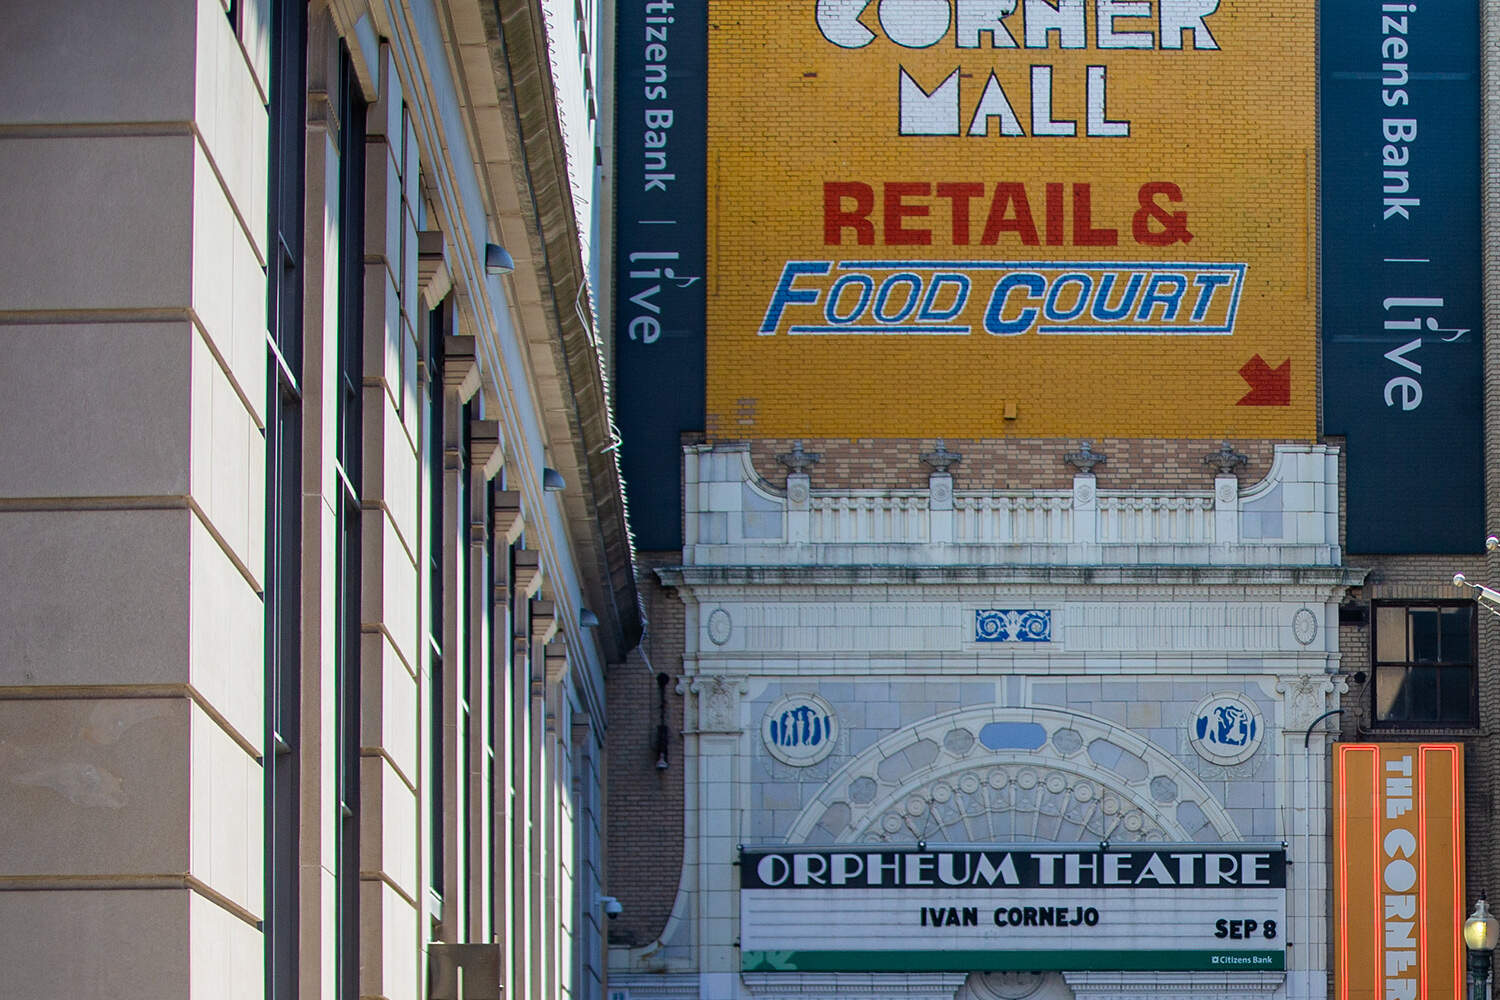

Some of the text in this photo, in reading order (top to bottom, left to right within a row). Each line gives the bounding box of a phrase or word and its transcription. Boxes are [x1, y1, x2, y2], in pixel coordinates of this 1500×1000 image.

[814, 0, 1222, 50] CORNER
[898, 63, 1131, 138] MALL
[644, 109, 676, 191] Bank
[1382, 118, 1421, 221] Bank
[822, 181, 1195, 247] RETAIL &
[628, 252, 690, 344] live
[757, 260, 1234, 336] FOOD COURT
[1383, 297, 1456, 411] live
[1386, 755, 1413, 819] THE
[757, 852, 1270, 886] ORPHEUM THEATRE
[920, 906, 1100, 927] IVAN CORNEJO
[1214, 919, 1277, 939] SEP 8
[1220, 955, 1272, 964] Citizens Bank
